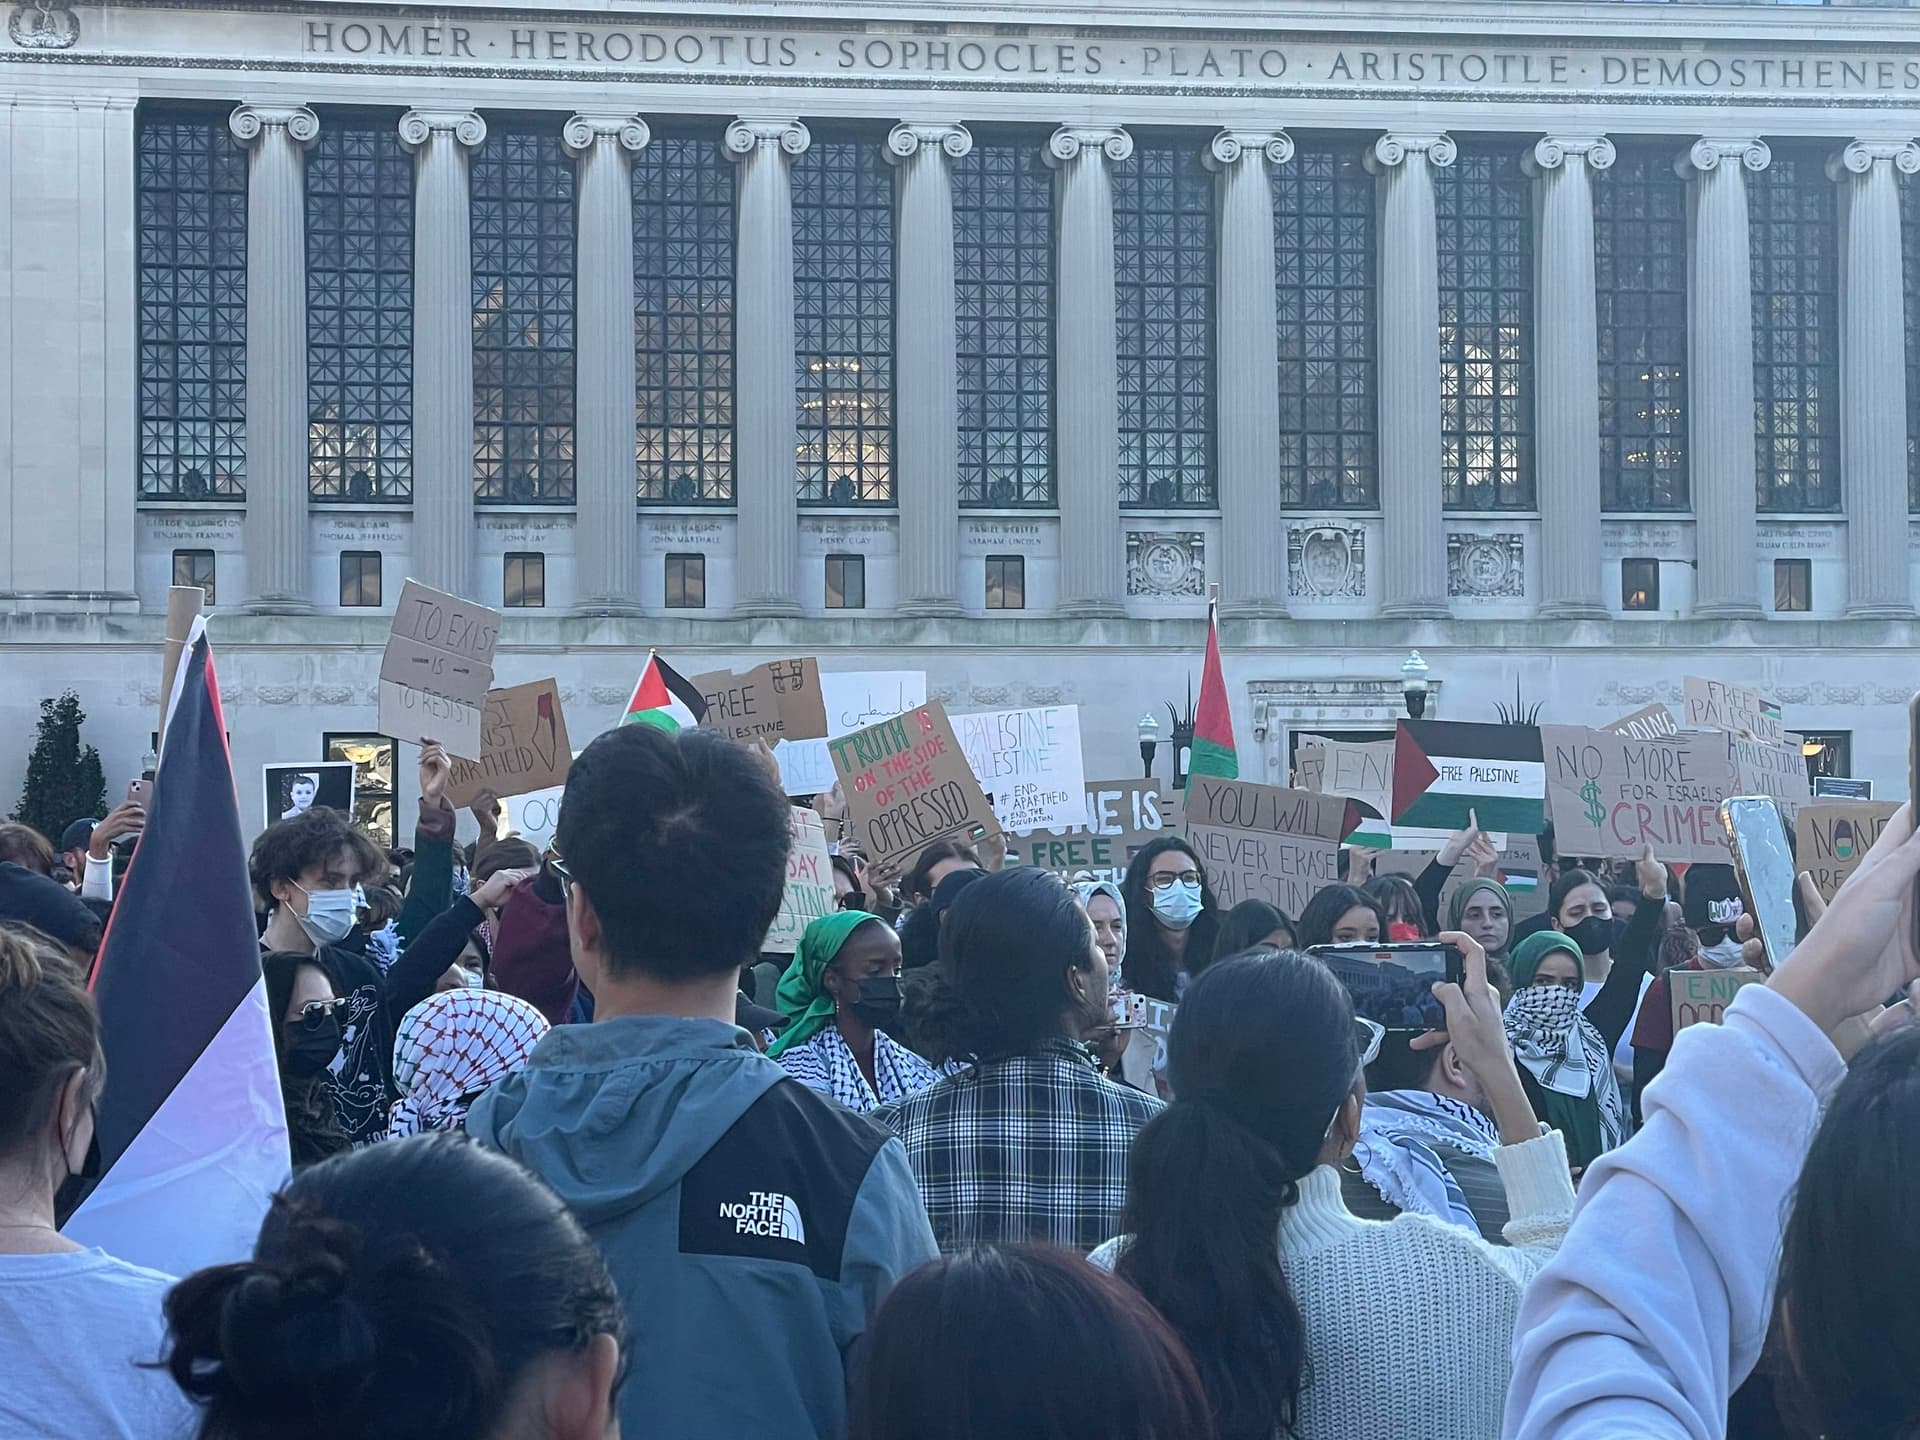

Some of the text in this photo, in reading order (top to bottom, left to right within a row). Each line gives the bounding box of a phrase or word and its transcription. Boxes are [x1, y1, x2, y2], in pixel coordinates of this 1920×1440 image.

[306, 21, 1920, 90] HOMER HERODOTUS SOPHOCLES PLATO ARISTOTLE DEMOSTHENES
[503, 535, 547, 543] JOHN JAY
[414, 598, 499, 651] TO EXIST
[395, 681, 416, 710] TO
[422, 686, 475, 728] RESIST
[705, 685, 758, 724] FREE
[1706, 680, 1755, 714] FREE
[727, 719, 786, 741] LESTINE
[829, 716, 911, 774] TRUTH
[963, 708, 1059, 752] PALESTINE
[854, 734, 949, 793] ON THE SIDE
[1334, 748, 1394, 791] EN
[1441, 765, 1521, 785] FREE PALESTINE
[1555, 743, 1604, 781] NO
[1622, 744, 1696, 783] MORE
[875, 764, 937, 808] OF THE
[1013, 791, 1069, 811] APARTHEID
[1014, 782, 1039, 798] END
[1202, 782, 1259, 829] YOU
[1619, 783, 1658, 801] FOR
[868, 780, 970, 856] OPPRESSED
[1131, 789, 1164, 833] IS
[787, 851, 820, 887] SAY
[1031, 838, 1113, 868] FREE
[1192, 831, 1339, 882] NEVER ERASE
[719, 1202, 782, 1223] NORTH
[748, 1191, 784, 1209] THE
[735, 1217, 781, 1238] FACE
